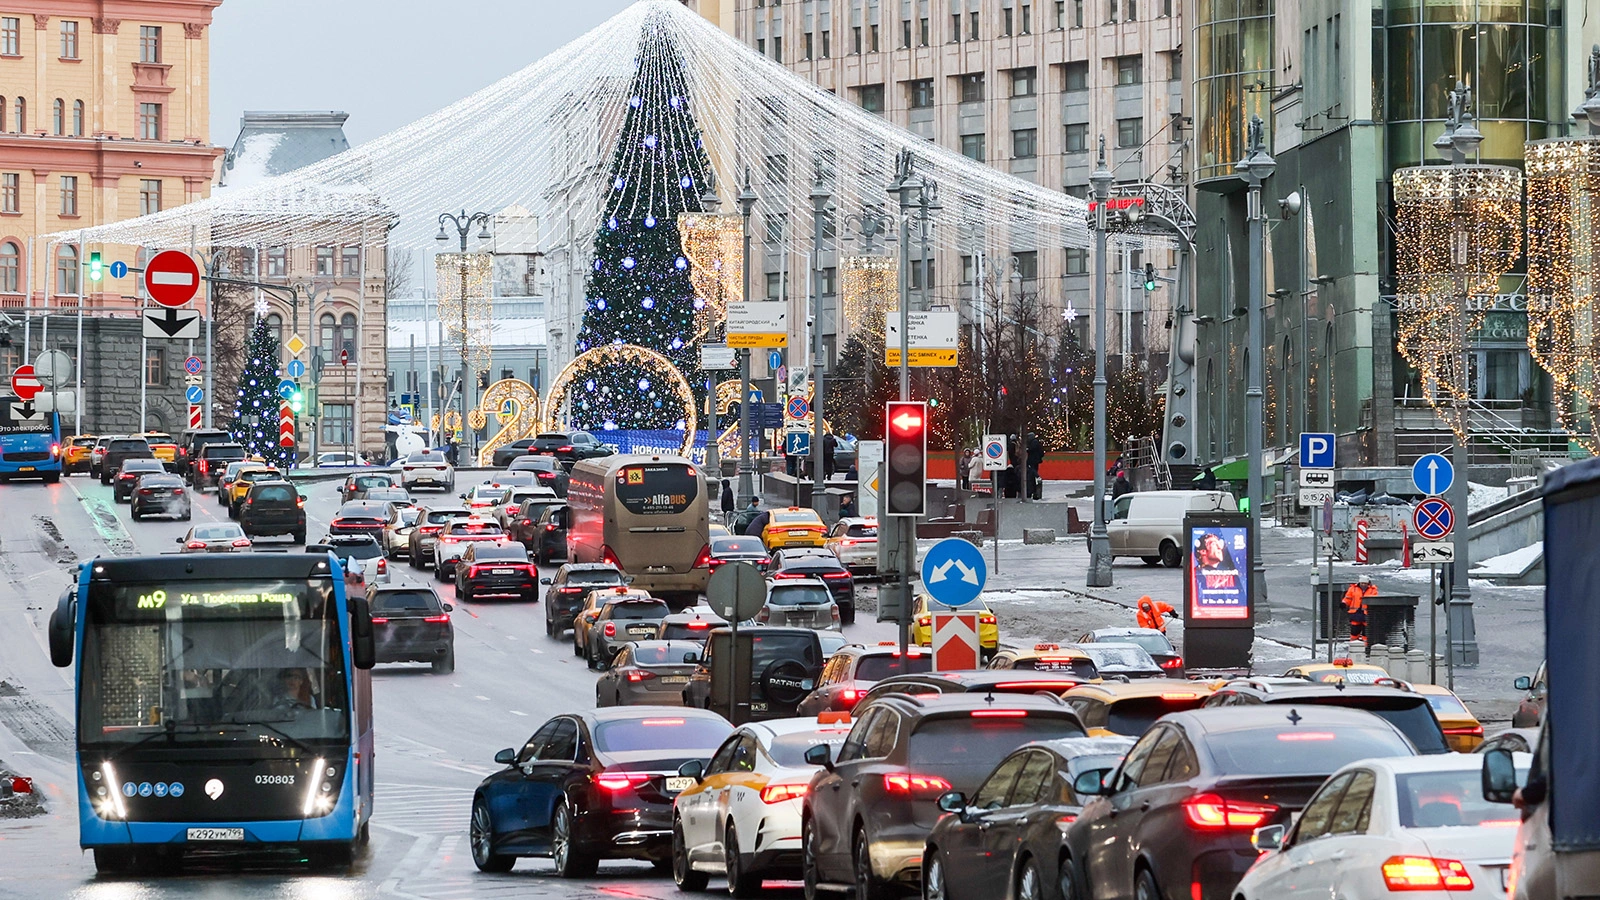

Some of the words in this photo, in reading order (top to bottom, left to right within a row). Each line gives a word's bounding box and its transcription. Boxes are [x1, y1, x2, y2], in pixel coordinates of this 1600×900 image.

[1308, 437, 1328, 464] P
[202, 593, 258, 604] Тюфелева
[261, 592, 293, 604] Роща
[769, 678, 802, 688] PATRIO
[255, 775, 295, 785] 030803
